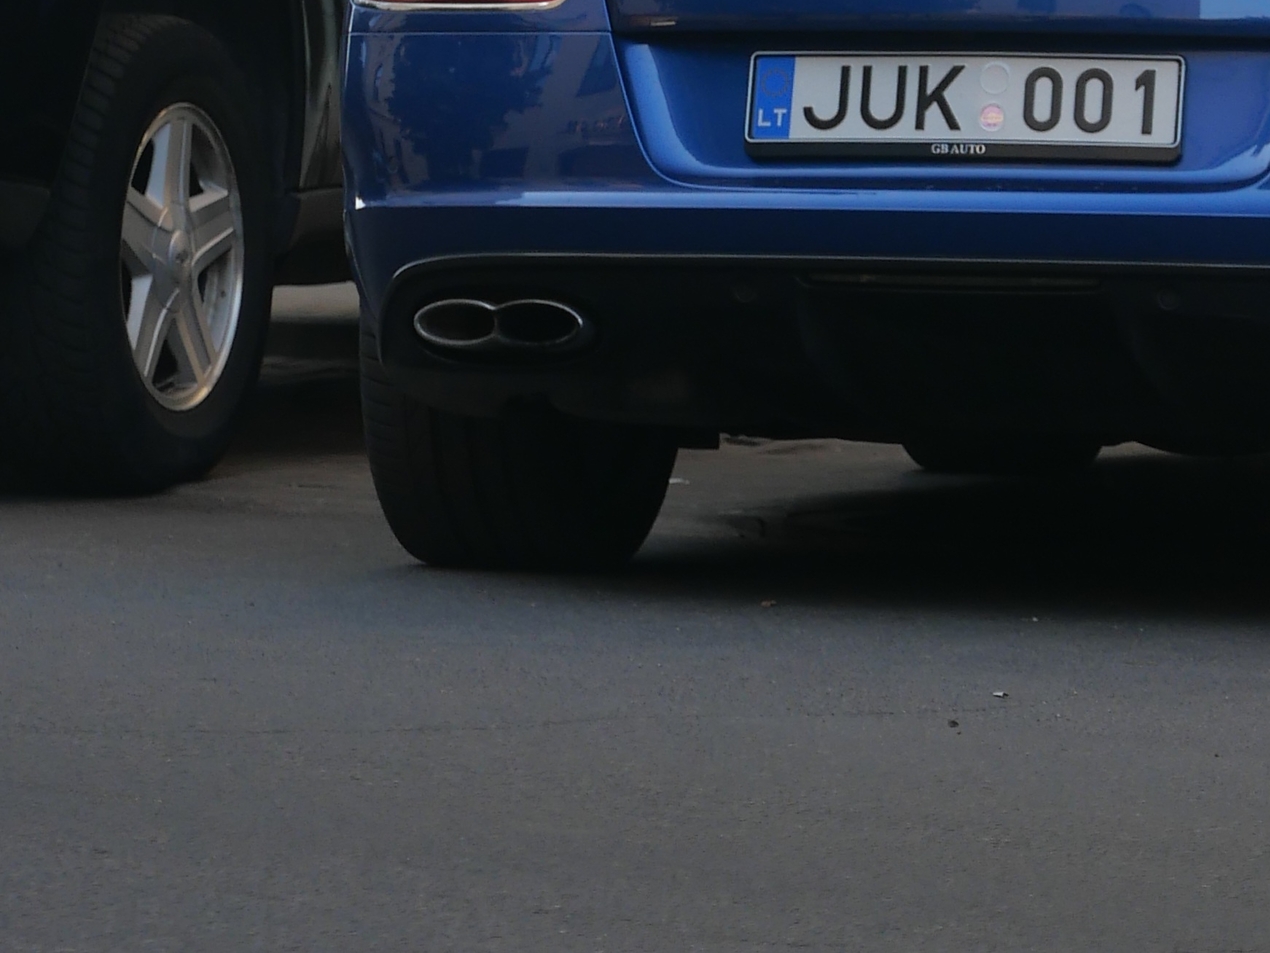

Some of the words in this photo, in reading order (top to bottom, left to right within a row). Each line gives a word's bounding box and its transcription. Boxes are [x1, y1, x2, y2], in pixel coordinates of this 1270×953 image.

[803, 65, 966, 131] JUK
[1022, 66, 1157, 135] 001
[757, 108, 788, 127] LT
[931, 143, 949, 154] GB
[950, 143, 986, 154] AUTO
